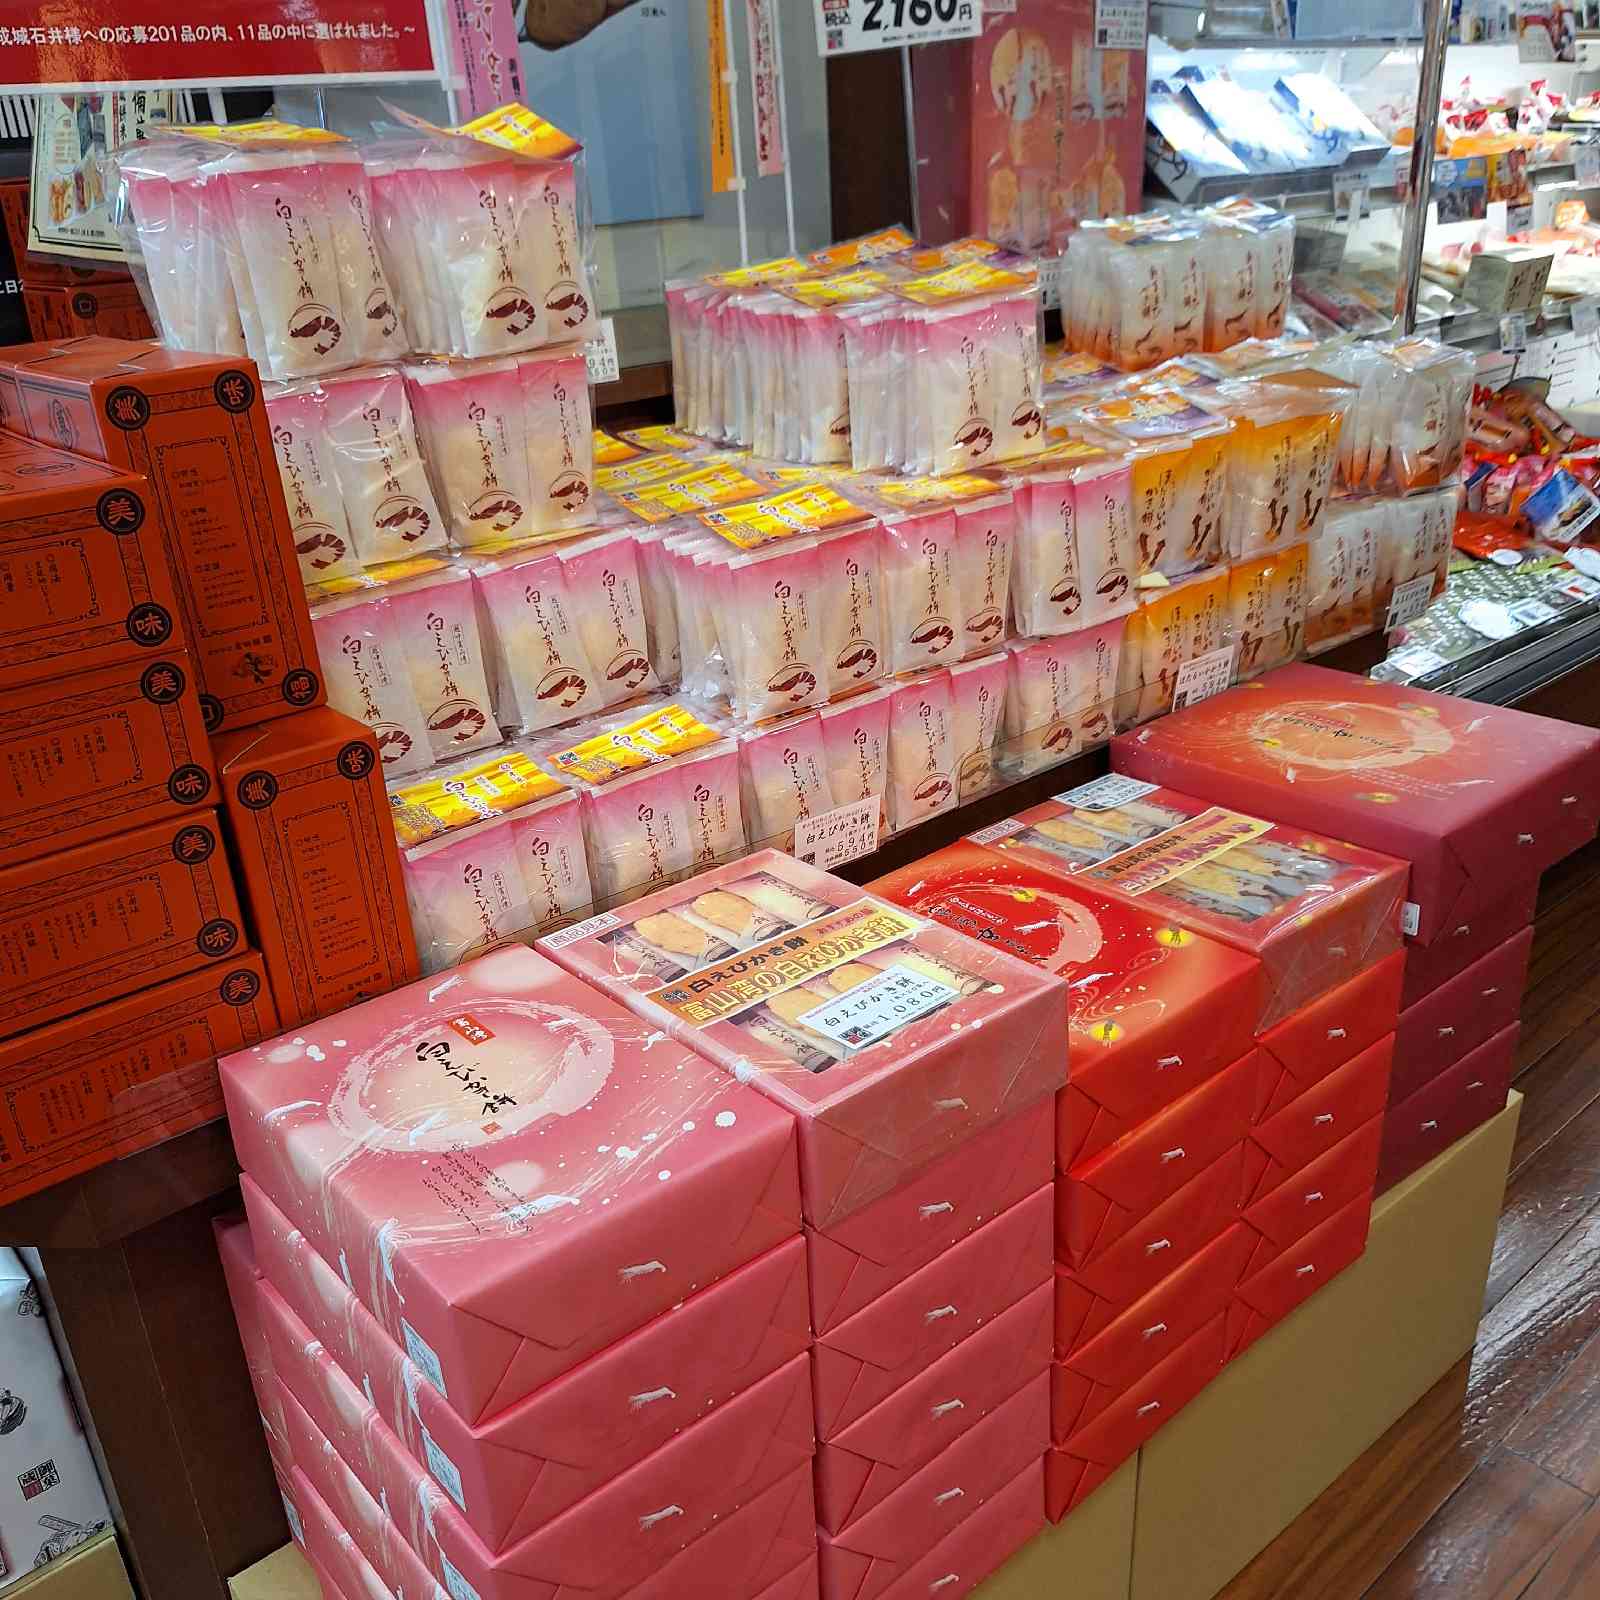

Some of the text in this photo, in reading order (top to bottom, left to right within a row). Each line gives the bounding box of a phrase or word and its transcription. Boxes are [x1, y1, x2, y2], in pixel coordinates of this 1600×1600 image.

[107, 498, 137, 524] 美
[136, 612, 163, 637] 味
[525, 585, 561, 666] 白えびかき餅
[602, 569, 630, 649] 白えびかき餅
[150, 670, 178, 696] 美
[342, 634, 383, 722] 白えびかき餅
[427, 612, 459, 697] 白えびかき餅
[175, 774, 205, 798] 味
[693, 783, 716, 862] 白えびかき餅
[638, 802, 665, 882] 白えびかき餅
[806, 812, 871, 846] 白えびかき餅
[464, 863, 498, 944] 白えびかき餅
[532, 836, 563, 918] 白えびかき餅
[679, 916, 910, 1022] 富山湾の白えびかき餅
[688, 935, 810, 993] 白えびかき餅
[823, 976, 916, 1028] 白えびかき餅
[881, 985, 945, 1022] 1,080円
